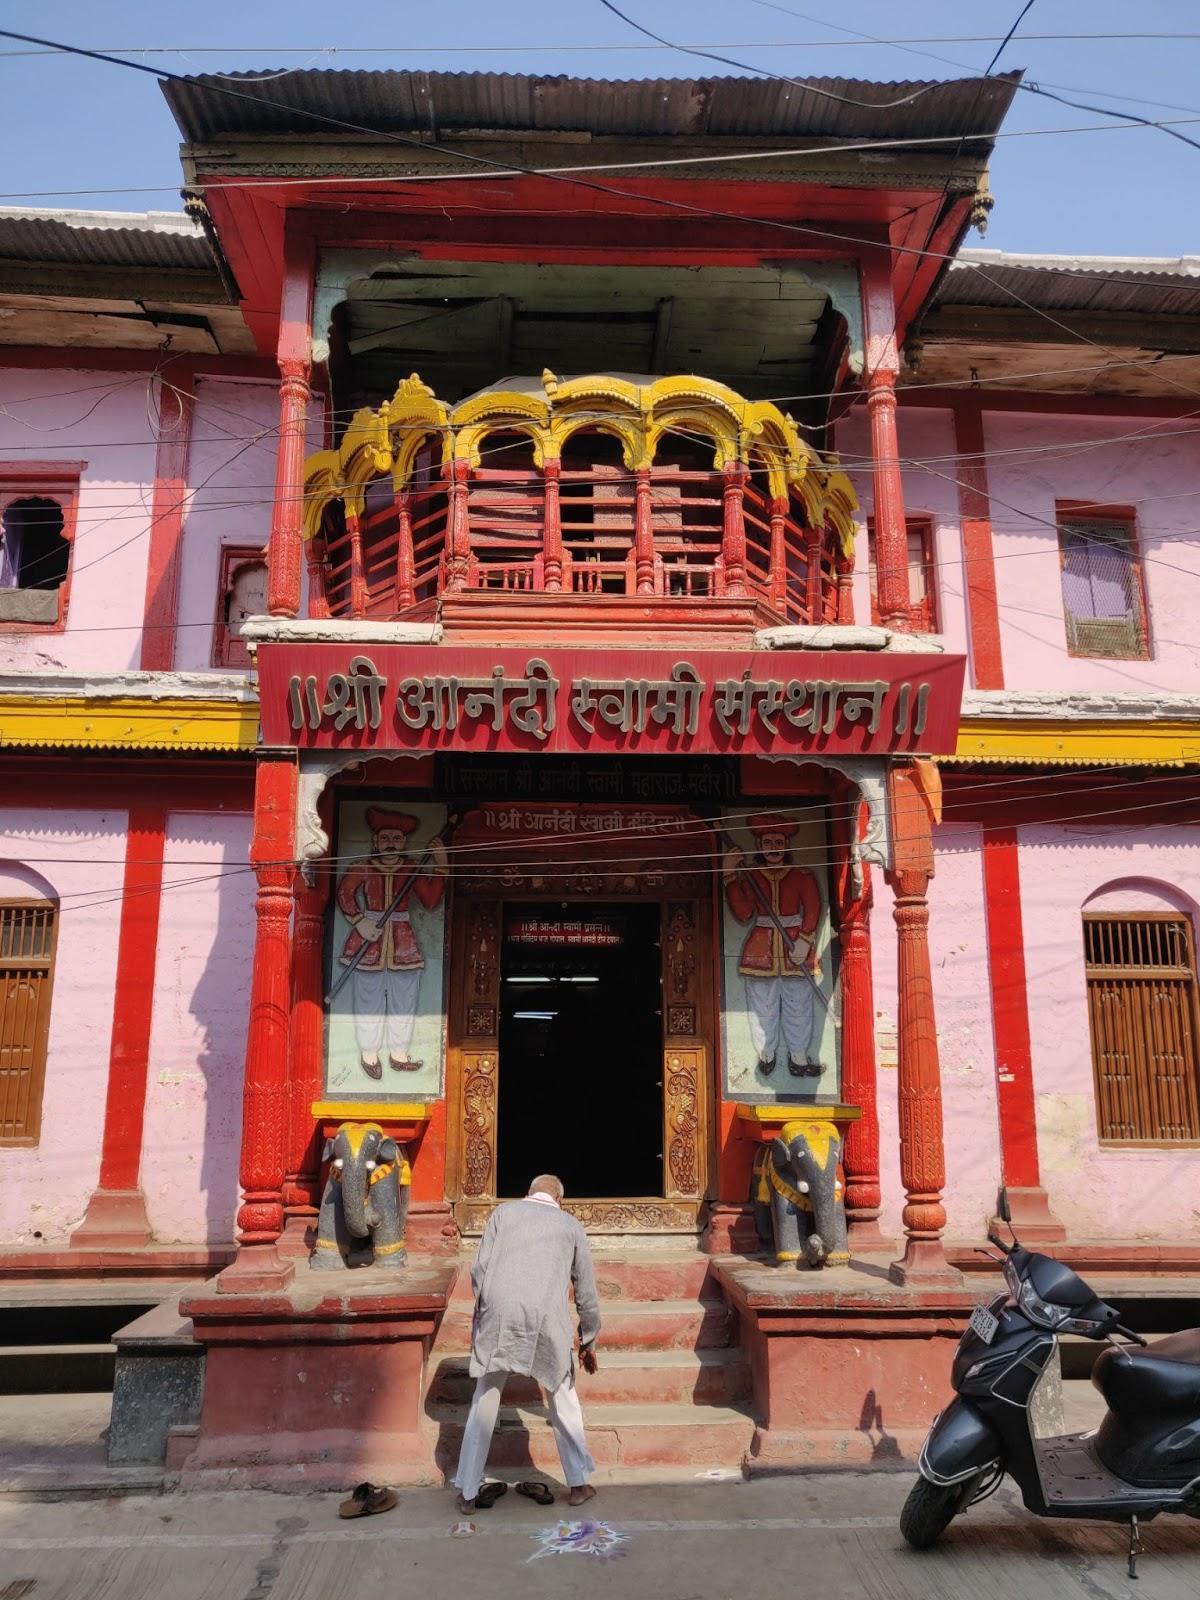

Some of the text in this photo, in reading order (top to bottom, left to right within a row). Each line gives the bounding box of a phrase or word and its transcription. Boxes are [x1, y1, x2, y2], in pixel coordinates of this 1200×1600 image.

[397, 658, 560, 740] आनंदी
[572, 661, 706, 735] स्वामी
[715, 669, 890, 735] संस्थान
[524, 808, 577, 832] आनंदी
[580, 810, 624, 832] स्वामी
